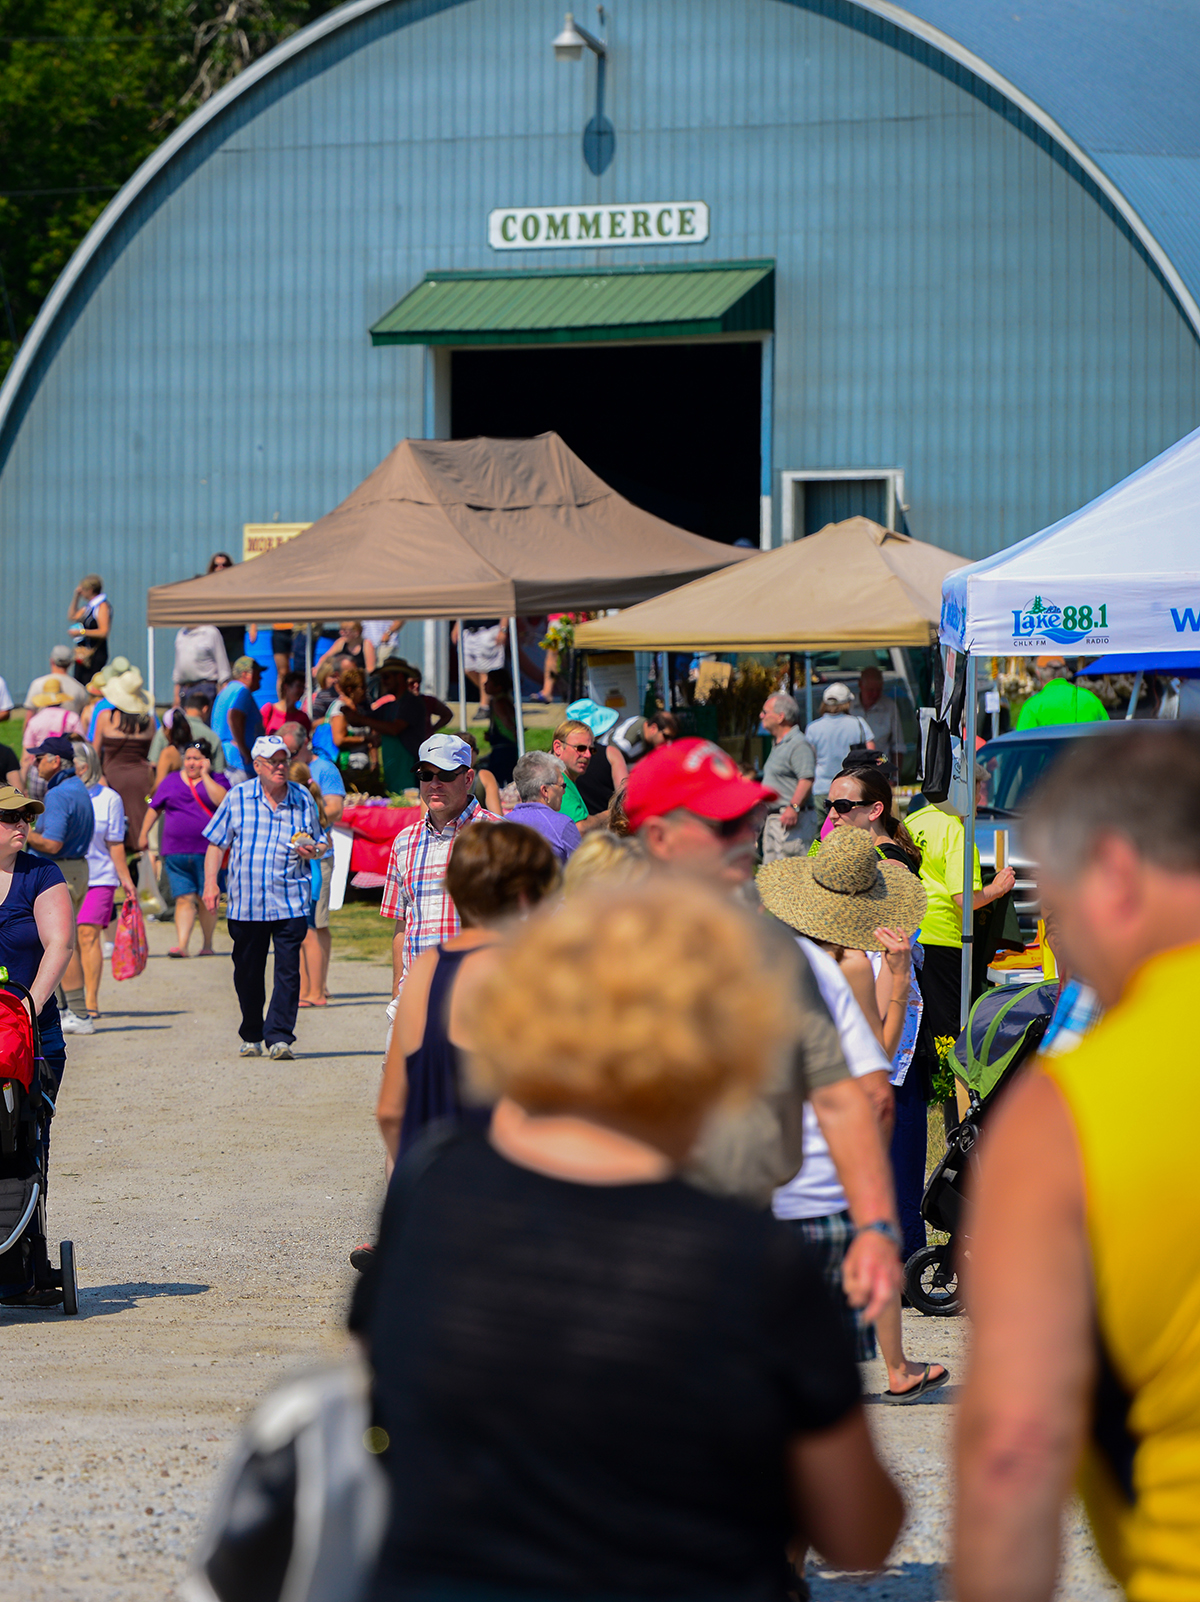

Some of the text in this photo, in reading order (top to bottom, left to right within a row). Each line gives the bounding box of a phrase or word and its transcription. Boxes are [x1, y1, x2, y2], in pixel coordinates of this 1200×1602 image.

[500, 208, 696, 242] COMMERCE
[1011, 603, 1109, 637] Lake 88.1
